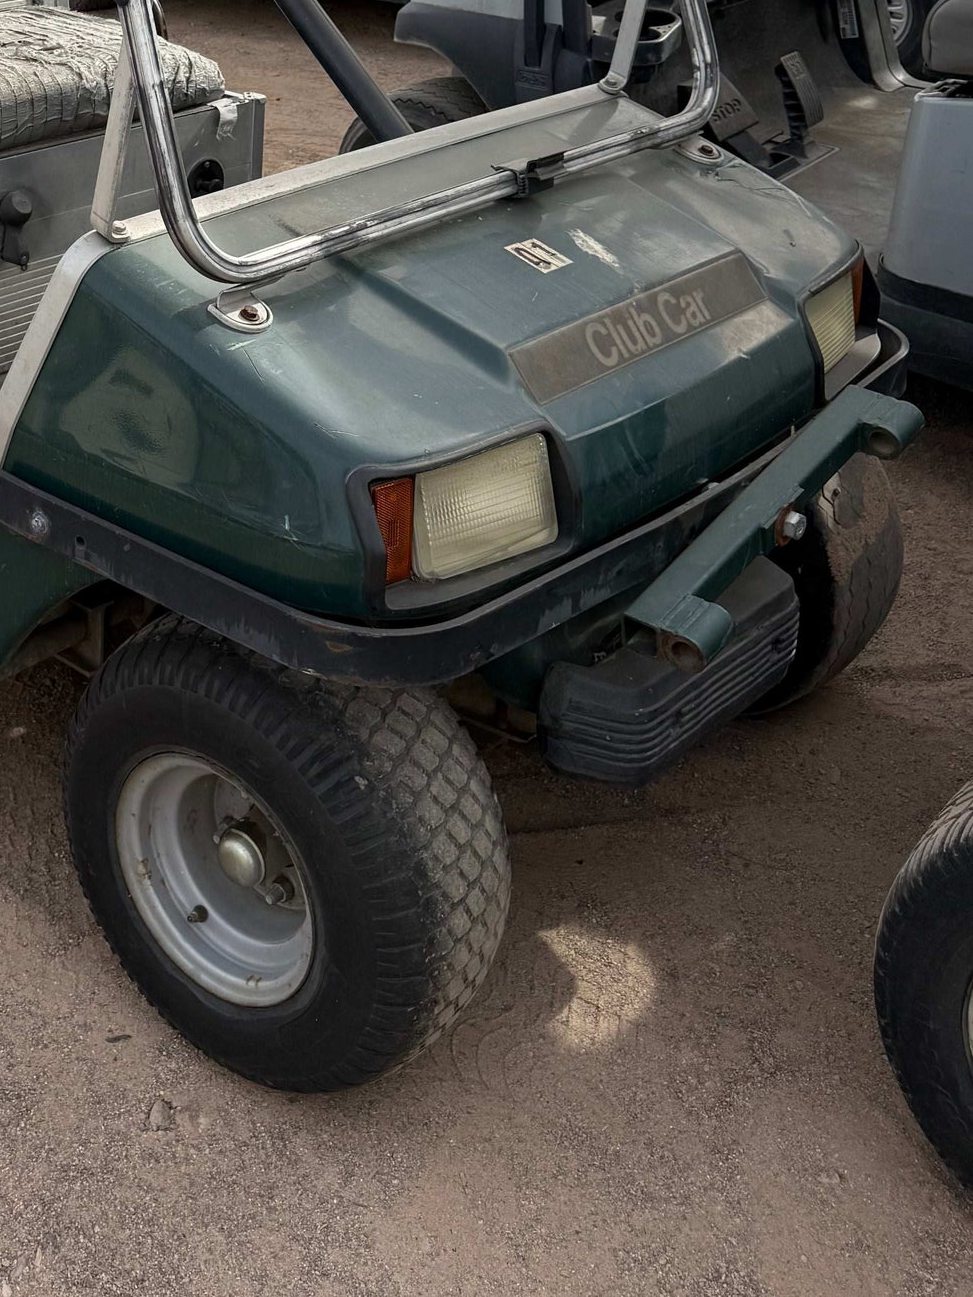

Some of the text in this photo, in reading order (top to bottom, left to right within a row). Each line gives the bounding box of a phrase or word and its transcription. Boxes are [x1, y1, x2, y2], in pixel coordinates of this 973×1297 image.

[711, 98, 741, 122] STOP
[585, 289, 712, 367] Club Car
